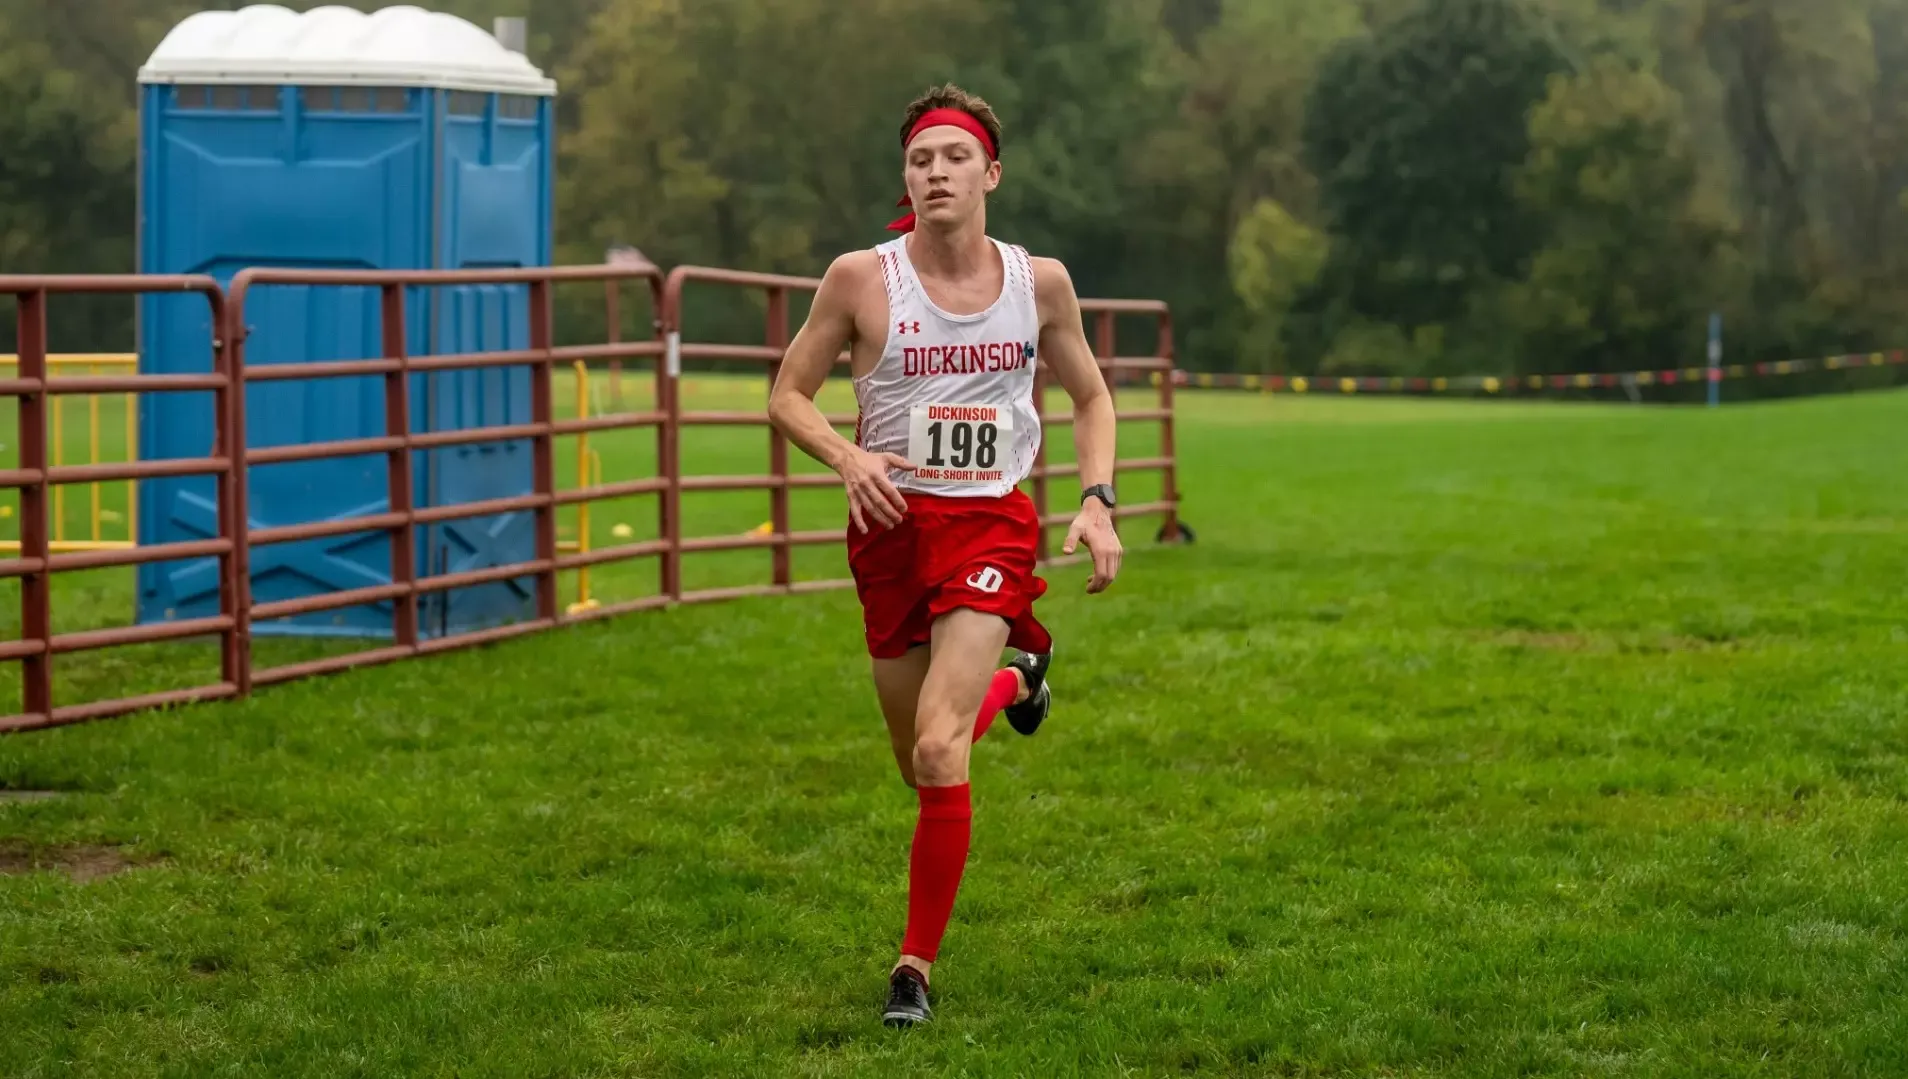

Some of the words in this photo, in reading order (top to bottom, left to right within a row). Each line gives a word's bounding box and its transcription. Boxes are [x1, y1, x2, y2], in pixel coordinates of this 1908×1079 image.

[903, 341, 1029, 377] DICKINSON
[928, 406, 997, 421] DICKINSON
[926, 422, 998, 469] 198
[914, 468, 973, 481] LONG-SHORT
[975, 470, 1004, 480] INVITE
